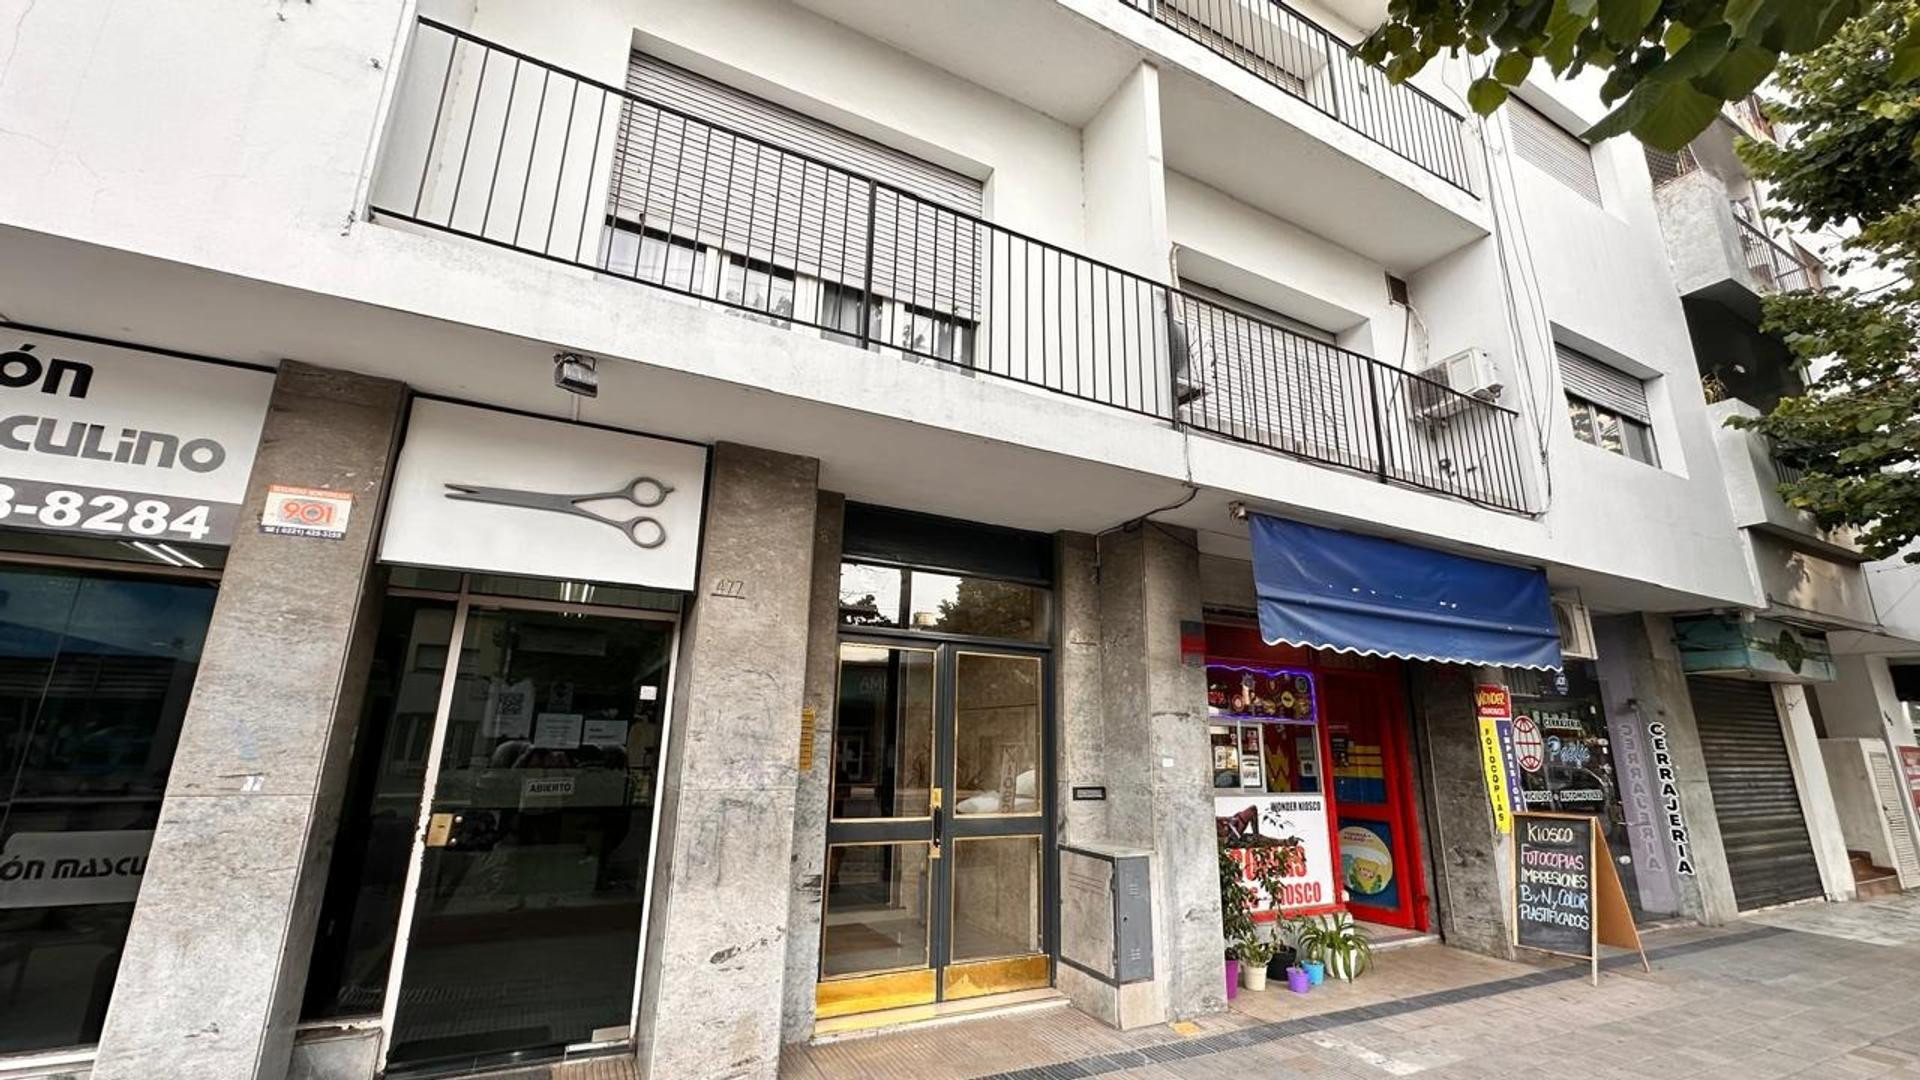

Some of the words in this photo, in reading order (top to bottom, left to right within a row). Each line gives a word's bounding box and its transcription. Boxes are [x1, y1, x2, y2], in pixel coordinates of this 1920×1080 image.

[283, 501, 334, 526] 901
[1484, 728, 1505, 822] FOTOCOPIAS
[1270, 801, 1297, 812] WONDER
[1648, 722, 1694, 875] CERRAJERIA
[1527, 823, 1574, 842] KIOSCO
[1520, 843, 1584, 871] FOTOCOPIAS
[1520, 867, 1588, 890] IMPRESIONES
[1558, 888, 1589, 913] COLOR
[1518, 903, 1590, 930] PLASTIFICADOS
